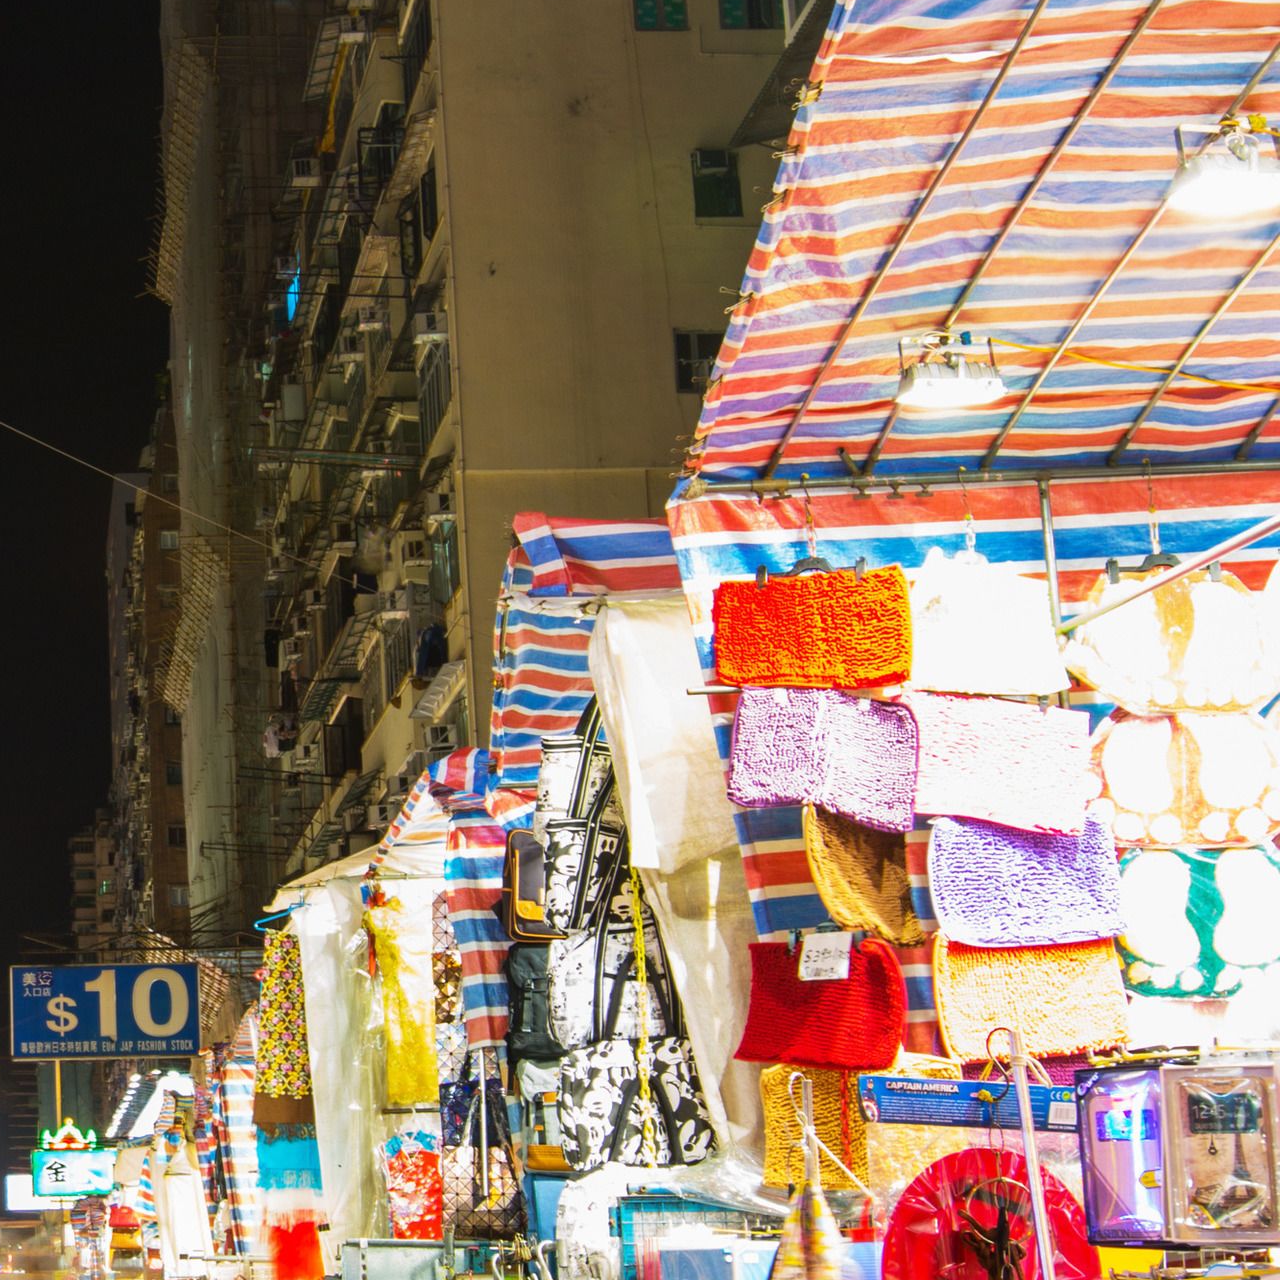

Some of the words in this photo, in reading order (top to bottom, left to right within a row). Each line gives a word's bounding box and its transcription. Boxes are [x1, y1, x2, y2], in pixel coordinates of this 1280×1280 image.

[46, 968, 189, 1040] $10
[120, 1040, 133, 1052] JAP
[138, 1040, 166, 1052] FASHION
[171, 1039, 193, 1051] STOCK
[886, 1081, 921, 1091] CAPTAIN
[923, 1083, 959, 1093] AMERICA
